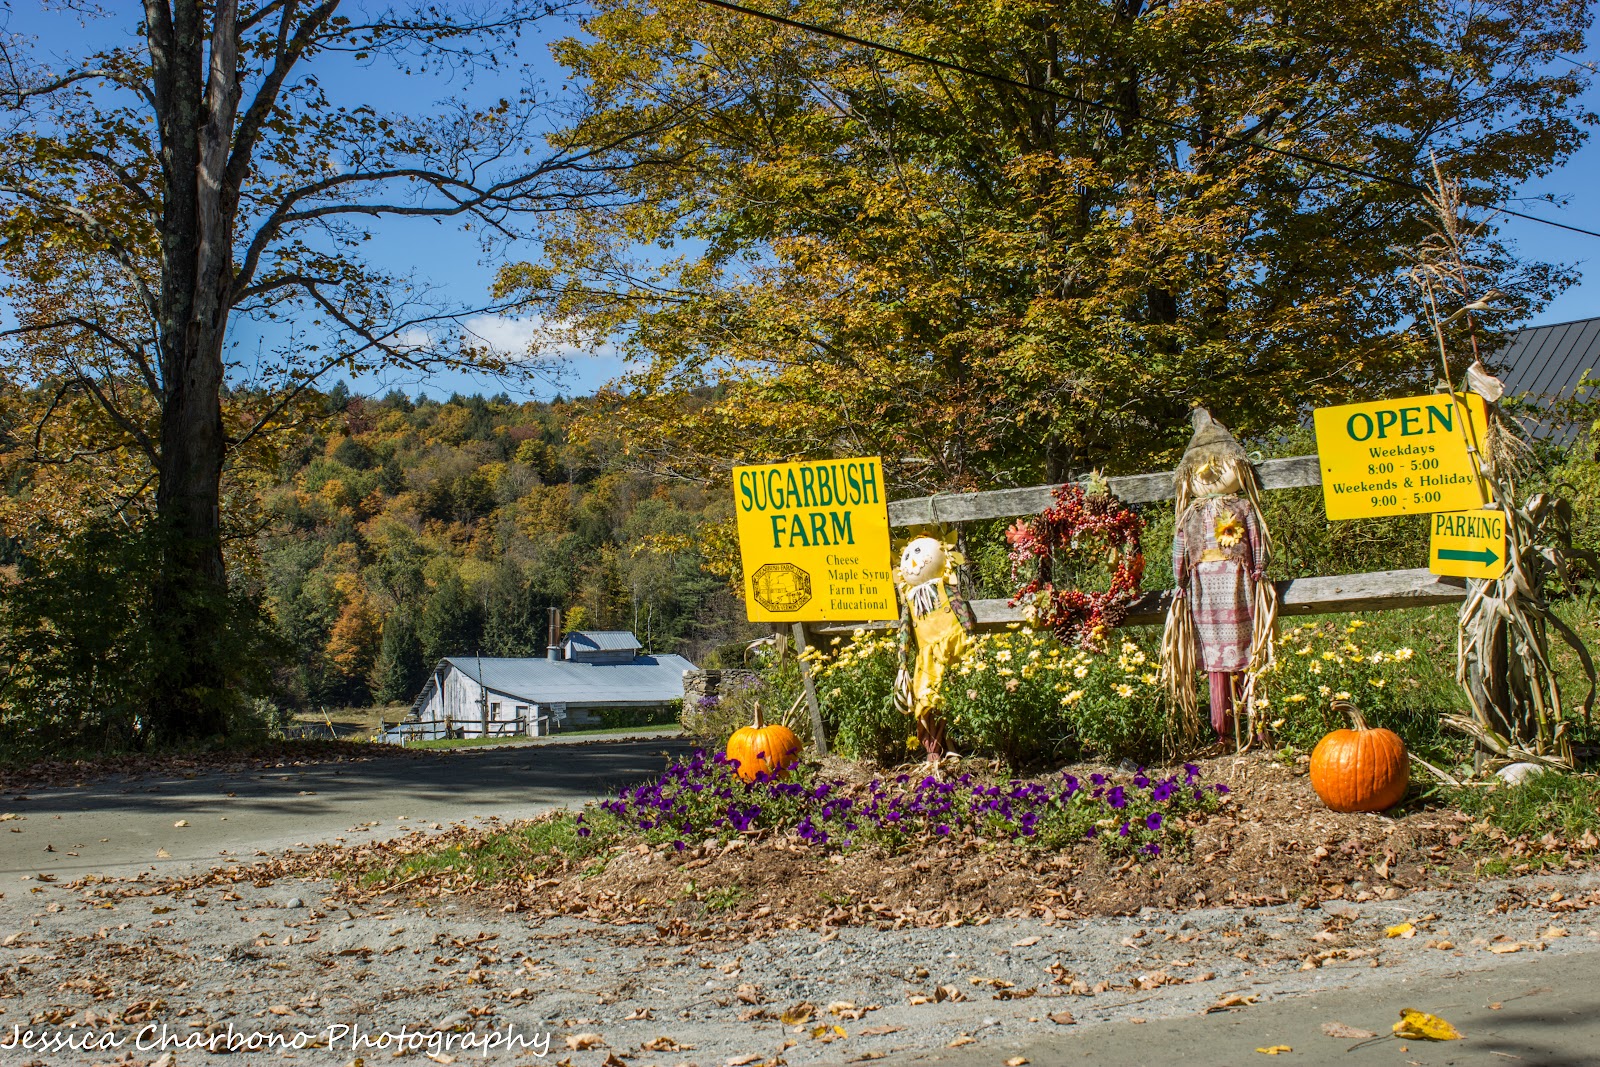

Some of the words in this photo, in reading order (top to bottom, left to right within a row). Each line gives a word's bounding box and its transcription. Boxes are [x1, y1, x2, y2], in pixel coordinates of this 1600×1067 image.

[1346, 403, 1454, 442] OPEN
[1369, 444, 1435, 459] Weekdays
[1368, 462, 1394, 475] 8:00
[1410, 458, 1439, 471] 5:00
[739, 462, 879, 512] SUGARBUSH
[1333, 480, 1398, 494] Weekends
[1403, 477, 1413, 488] &
[1420, 473, 1477, 487] Holiday
[1371, 495, 1397, 508] 9:00
[1413, 491, 1441, 504] 5:00
[770, 511, 855, 548] FARM
[1435, 514, 1501, 540] PARKING
[826, 554, 859, 566] Cheese
[828, 569, 858, 582] Maple
[862, 568, 890, 582] Syrup
[829, 584, 855, 595] Farm
[859, 583, 878, 595] Fun
[830, 599, 888, 610] Educational
